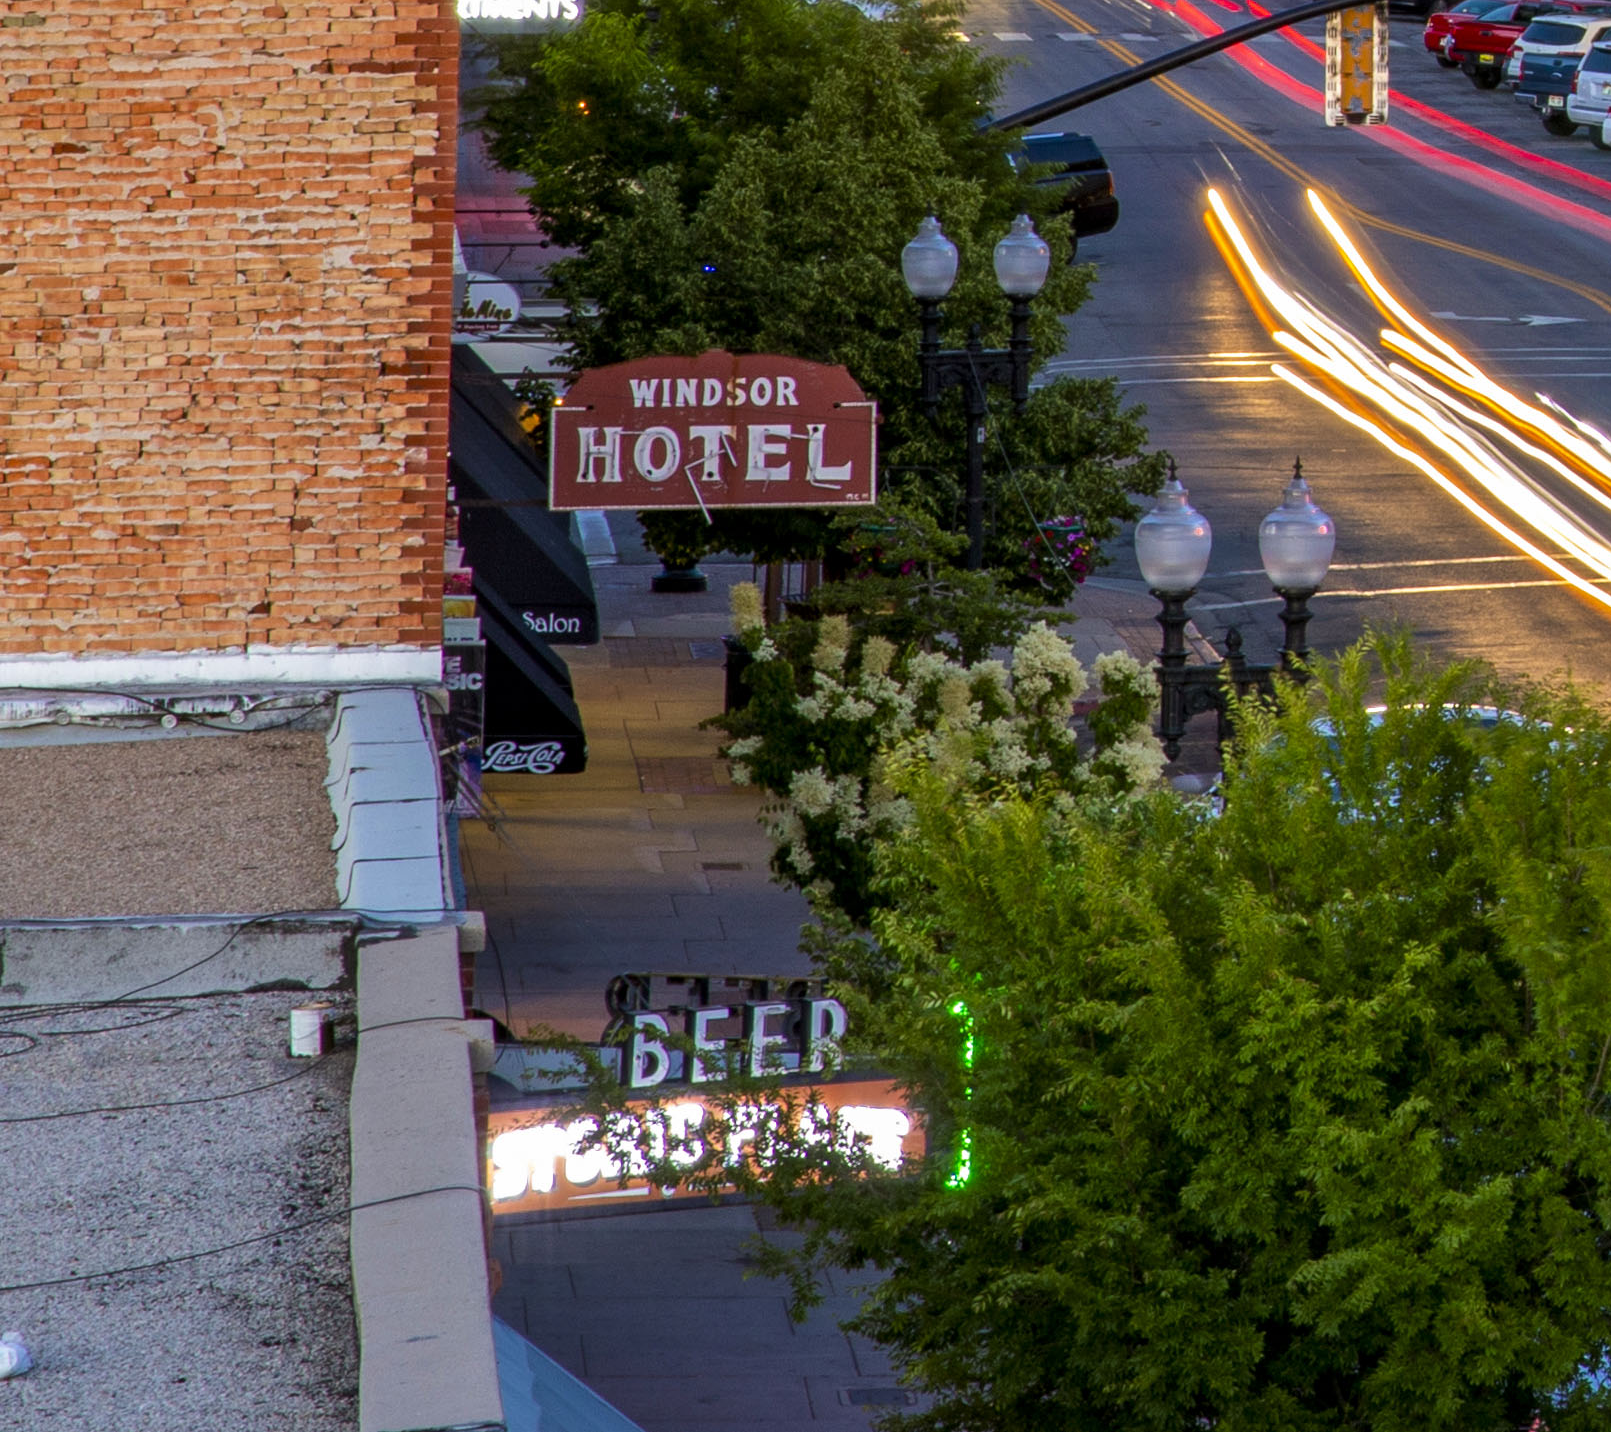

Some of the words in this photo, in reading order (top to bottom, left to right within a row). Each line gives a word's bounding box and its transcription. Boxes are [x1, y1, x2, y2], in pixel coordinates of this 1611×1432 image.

[629, 376, 799, 409] WINDSOR
[576, 423, 852, 484] HOTEL
[522, 611, 581, 634] Salon
[630, 997, 848, 1089] BEER
